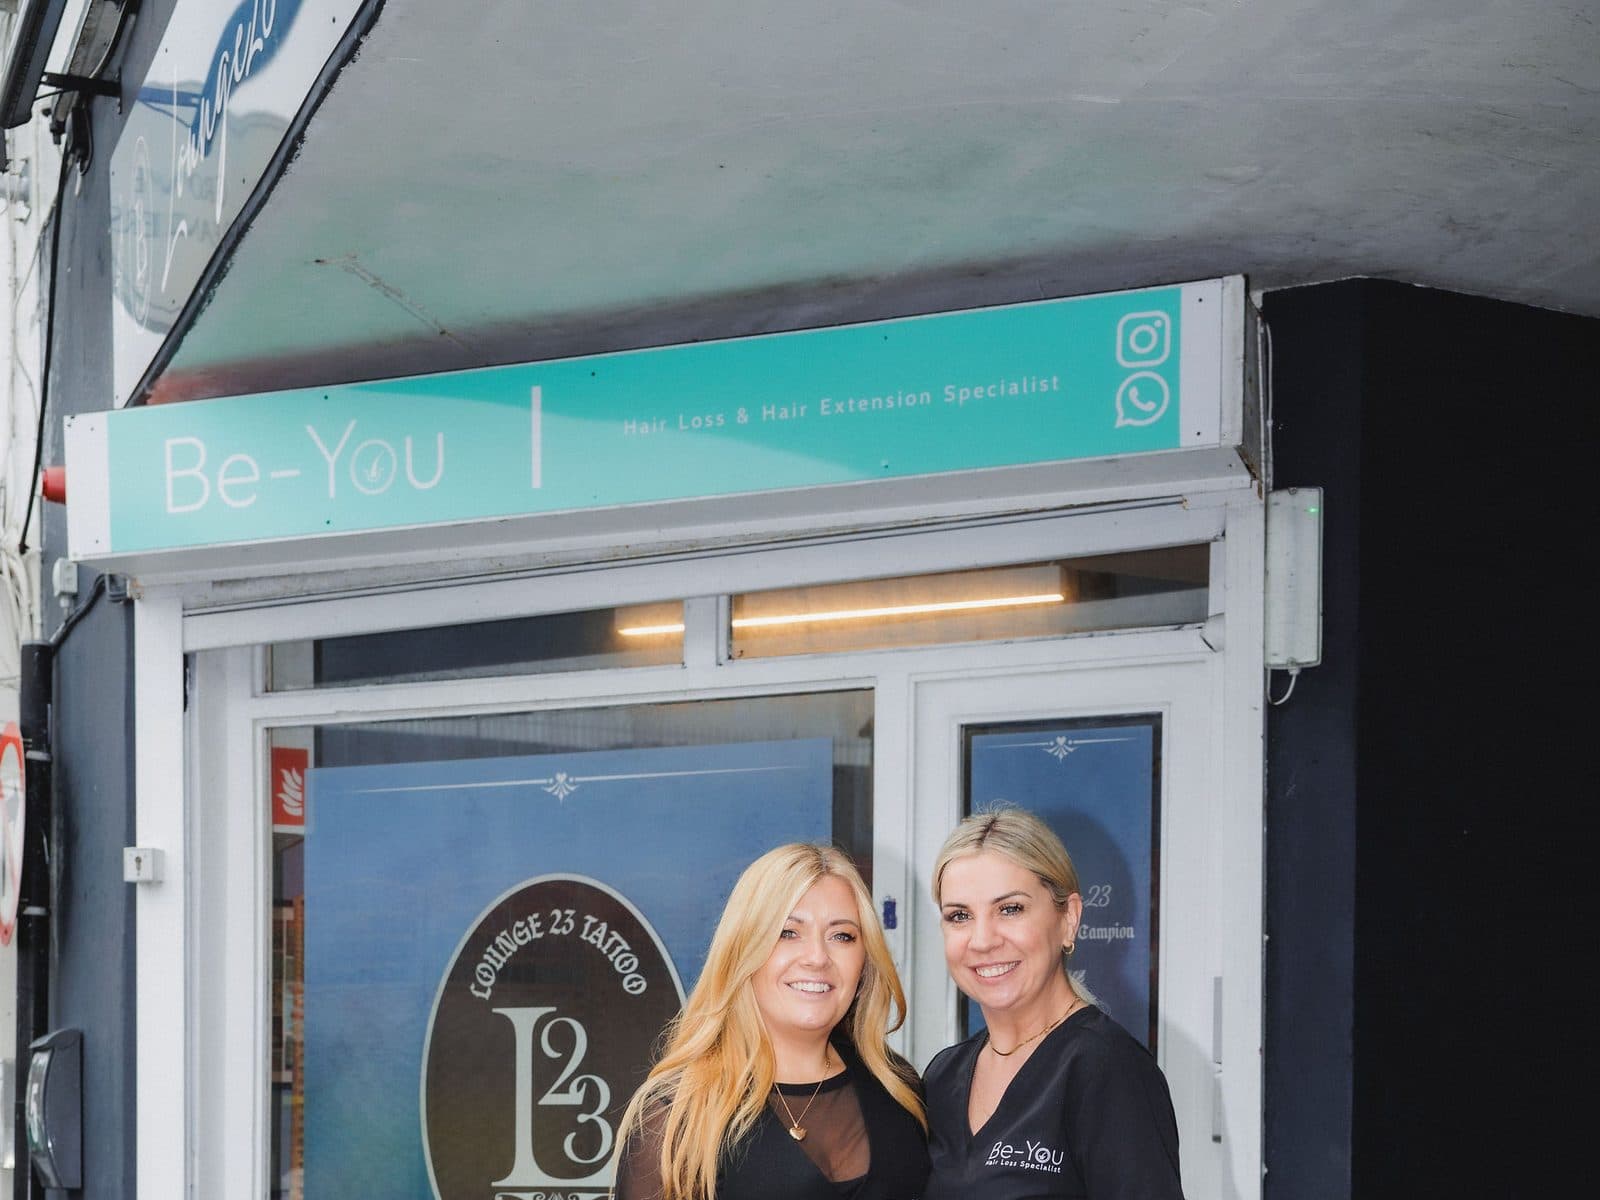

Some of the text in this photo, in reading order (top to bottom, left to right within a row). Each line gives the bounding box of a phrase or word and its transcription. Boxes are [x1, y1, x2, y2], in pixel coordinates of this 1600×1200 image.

[623, 376, 1060, 435] Hair Loss & Hair Extension Specialist
[164, 418, 444, 514] Be-You
[1083, 884, 1113, 908] 23
[1077, 921, 1136, 944] Campion
[470, 908, 647, 1000] LOUNGE 23 TATTOO
[988, 1139, 1064, 1166] Be-You
[984, 1159, 1062, 1174] Hair Loss Specialist
